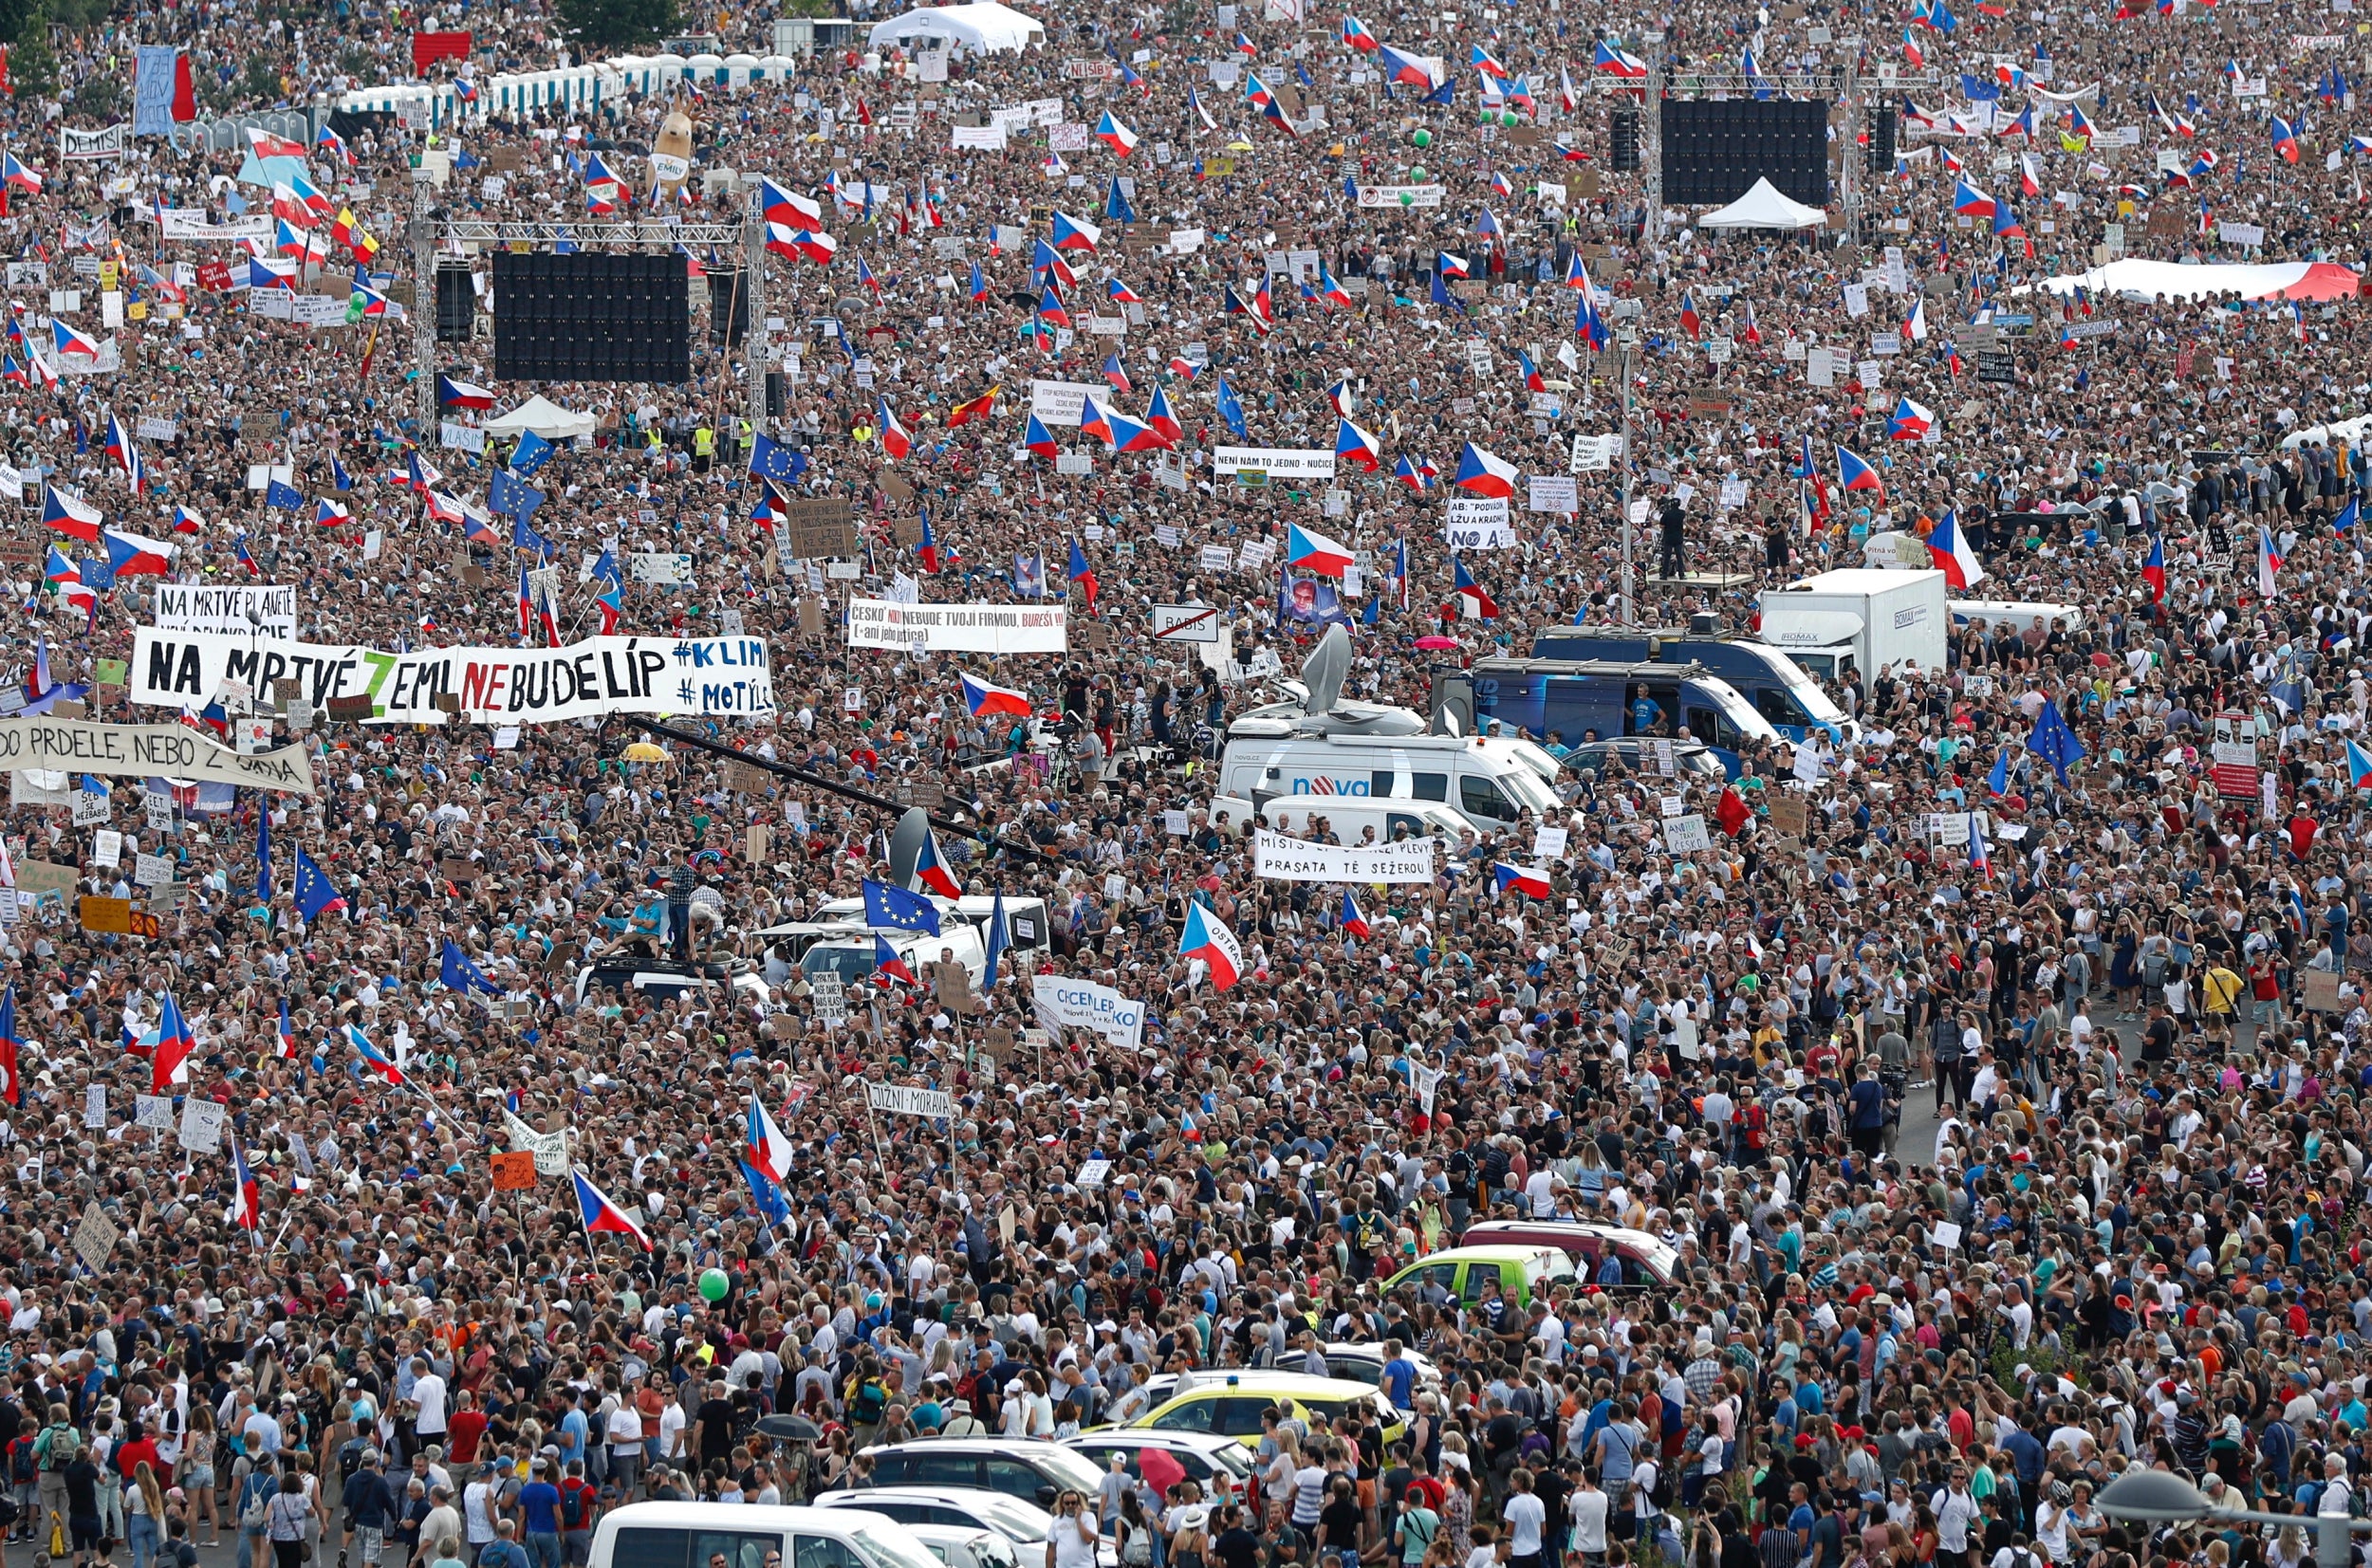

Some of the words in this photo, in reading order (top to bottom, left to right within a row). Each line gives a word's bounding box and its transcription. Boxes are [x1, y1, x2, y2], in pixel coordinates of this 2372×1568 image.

[658, 162, 683, 175] EMILY
[1031, 208, 1047, 220] NE
[1217, 455, 1238, 466] NENÍ
[1240, 454, 1259, 466] NÁM
[1261, 457, 1271, 466] TO
[1273, 457, 1299, 468] JEDNO
[1306, 456, 1333, 469] NUČICE
[1452, 503, 1468, 511] AB:
[1451, 514, 1470, 524] LŽU
[1867, 545, 1885, 554] Pitná
[160, 588, 188, 618] NA
[193, 586, 241, 618] MRTVÉ
[902, 611, 943, 626] NEBUDE
[945, 609, 976, 627] TVOJÍ
[978, 612, 1020, 630] FIRMOU,
[1021, 610, 1053, 628] BUREŠI
[1055, 612, 1064, 628] !!!
[148, 641, 202, 696] NA
[225, 648, 357, 710] MRTVÉ
[30, 727, 125, 764] PRDELE,
[134, 733, 195, 766] NEBO
[1293, 775, 1371, 798] nova
[76, 806, 108, 821] NEZBABIŠ
[1265, 859, 1326, 875] PRASATA
[1344, 859, 1360, 874] TĚ
[1610, 937, 1628, 952] NO
[874, 1085, 904, 1108] JIŽNÍ
[910, 1090, 950, 1115] MORAVA
